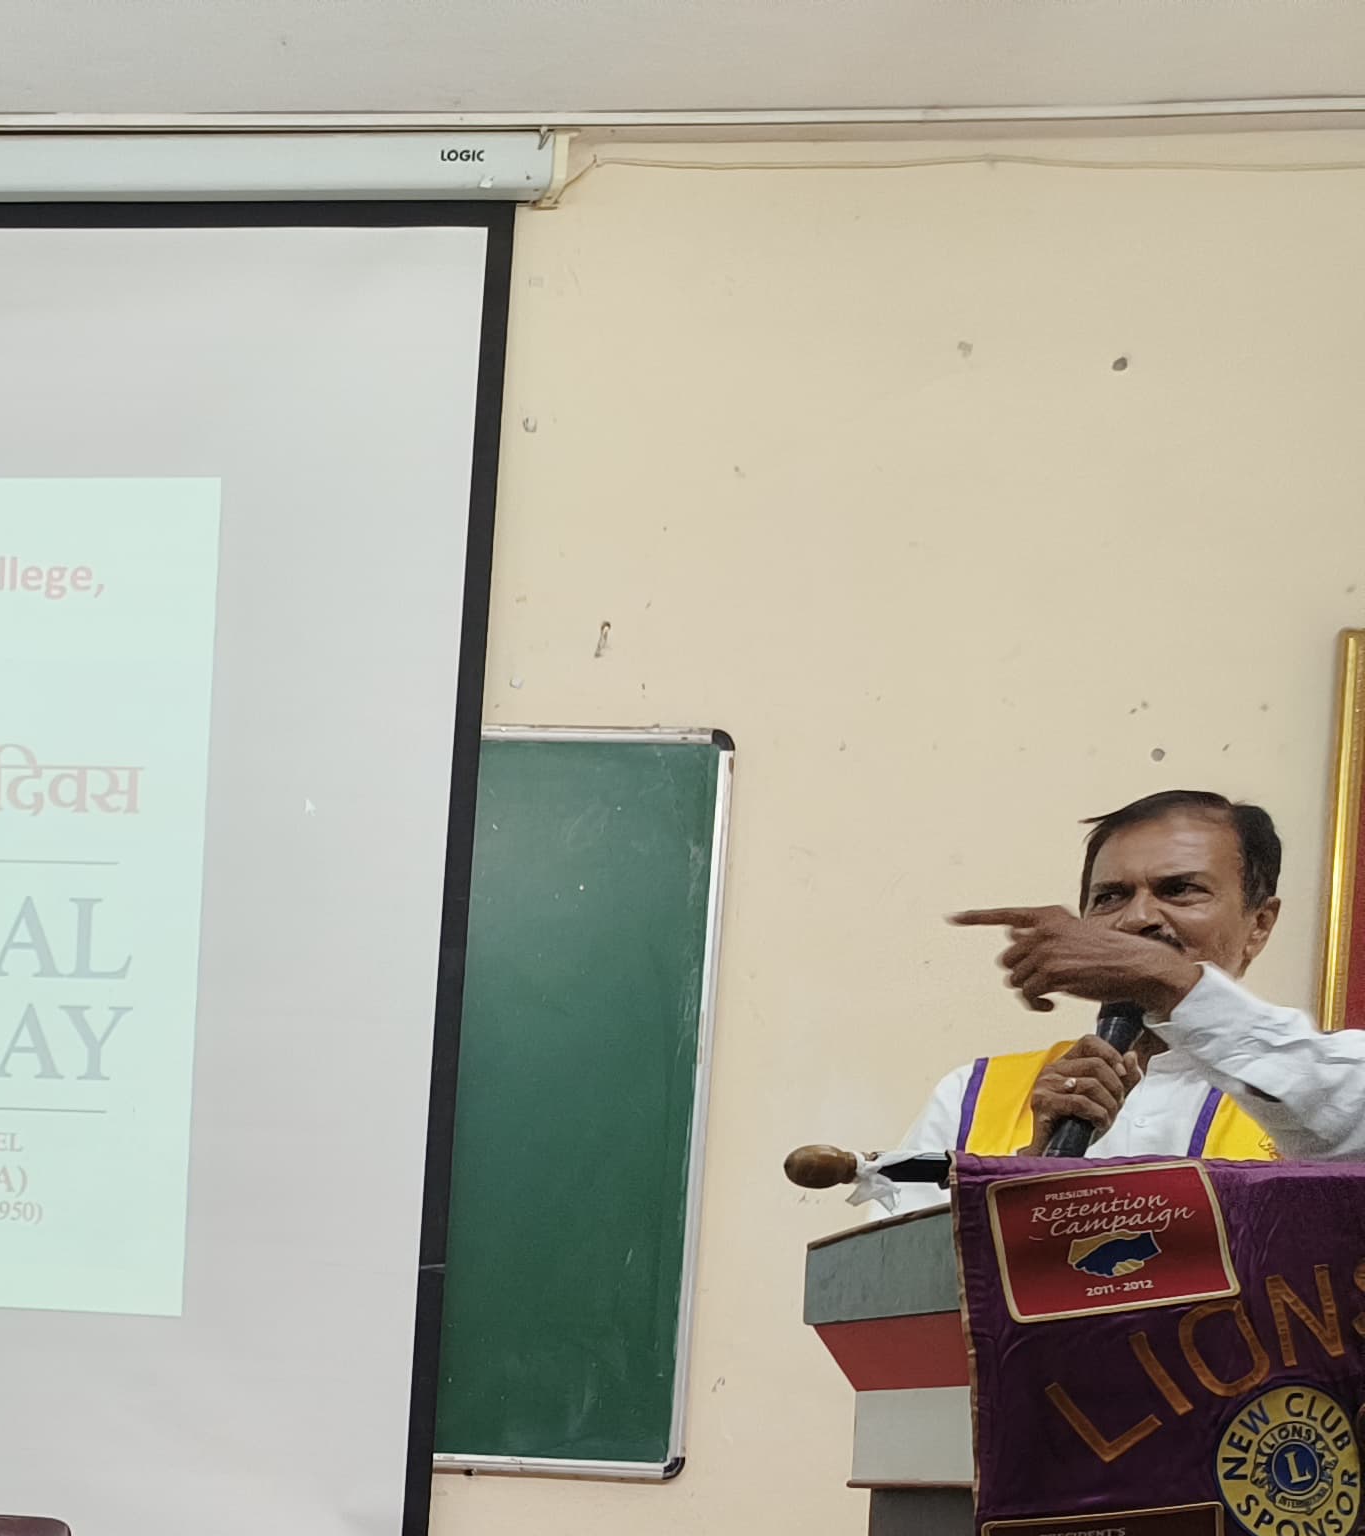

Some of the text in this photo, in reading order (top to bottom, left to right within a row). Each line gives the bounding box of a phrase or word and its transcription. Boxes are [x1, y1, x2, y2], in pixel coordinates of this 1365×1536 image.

[440, 149, 485, 162] LOGIC
[1031, 1193, 1169, 1223] Retention
[1050, 1205, 1196, 1236] Campaign
[1044, 1258, 1365, 1464] LION
[1221, 1392, 1353, 1481] NEW CLUB
[1264, 1424, 1313, 1451] LIONS
[1284, 1450, 1314, 1484] L
